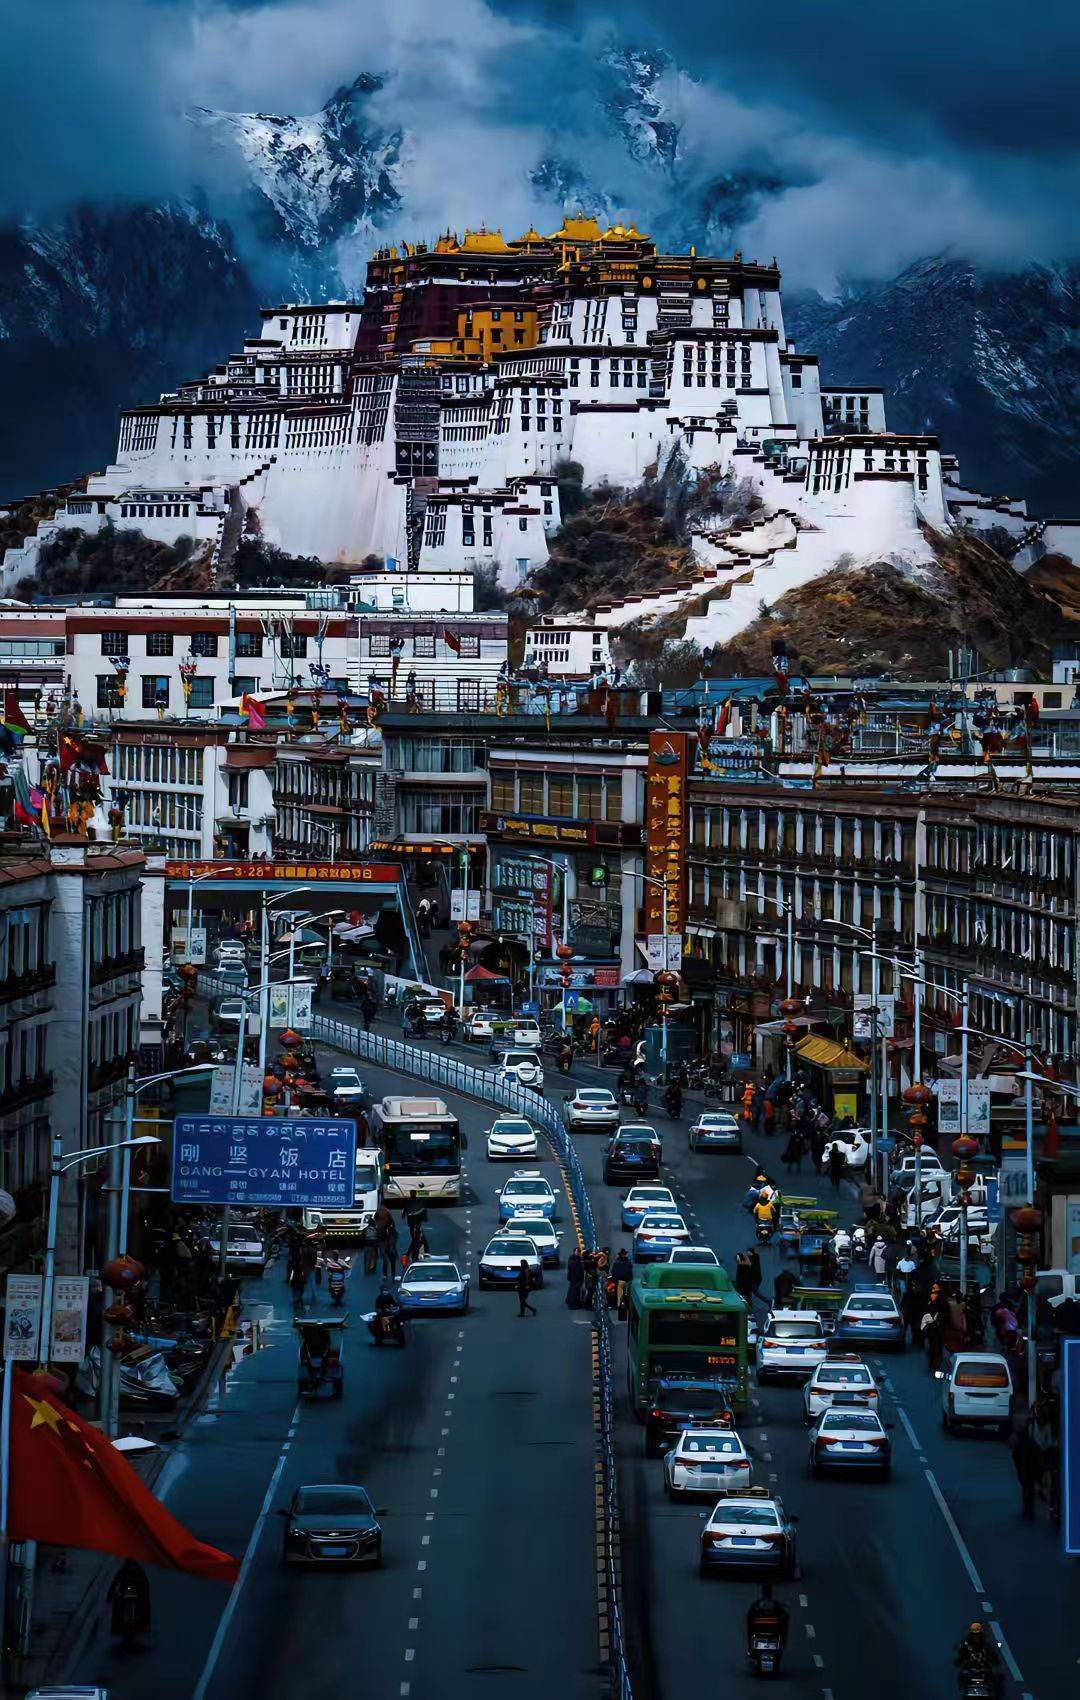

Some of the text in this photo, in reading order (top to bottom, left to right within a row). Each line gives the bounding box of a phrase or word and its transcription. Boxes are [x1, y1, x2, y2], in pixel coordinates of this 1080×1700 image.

[180, 1143, 348, 1169] 刚坚饭店
[299, 1169, 346, 1180] HOTEL
